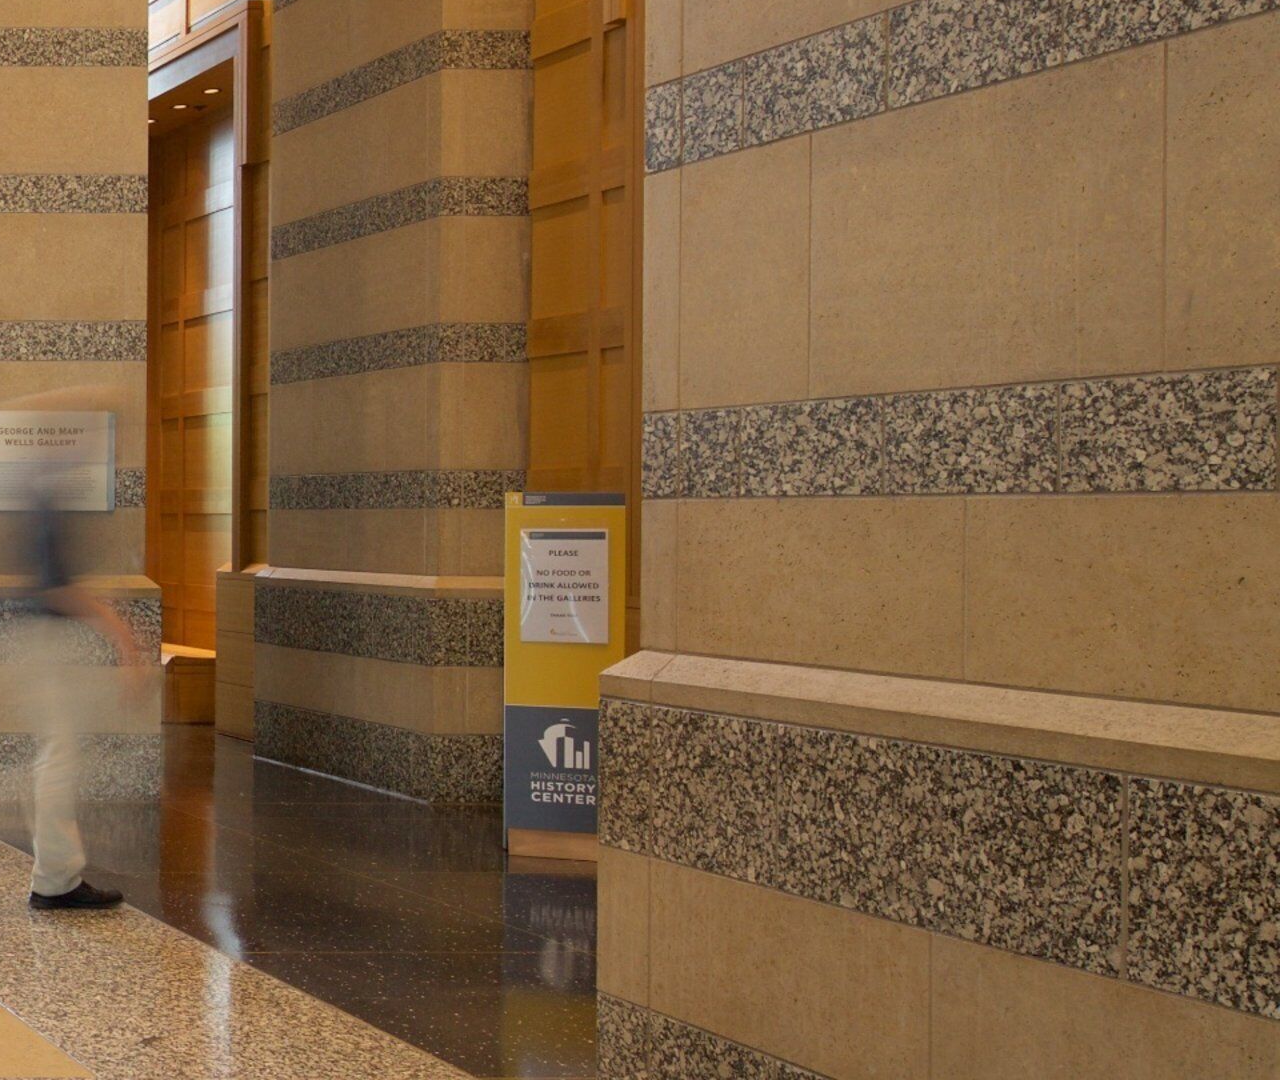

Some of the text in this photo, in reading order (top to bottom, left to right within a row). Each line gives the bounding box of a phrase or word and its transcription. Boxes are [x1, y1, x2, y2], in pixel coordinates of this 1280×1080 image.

[36, 427, 56, 436] AND
[58, 427, 85, 436] MARY
[4, 438, 78, 447] WELLS GALLERY
[548, 549, 579, 557] PLEASE
[536, 569, 592, 577] NO FOOD OR
[528, 582, 600, 590] DRINK ALLOWED
[538, 594, 554, 602] THE
[530, 771, 596, 782] MINNESOTA
[530, 781, 596, 794] HISTORY
[531, 791, 597, 805] CENTER
